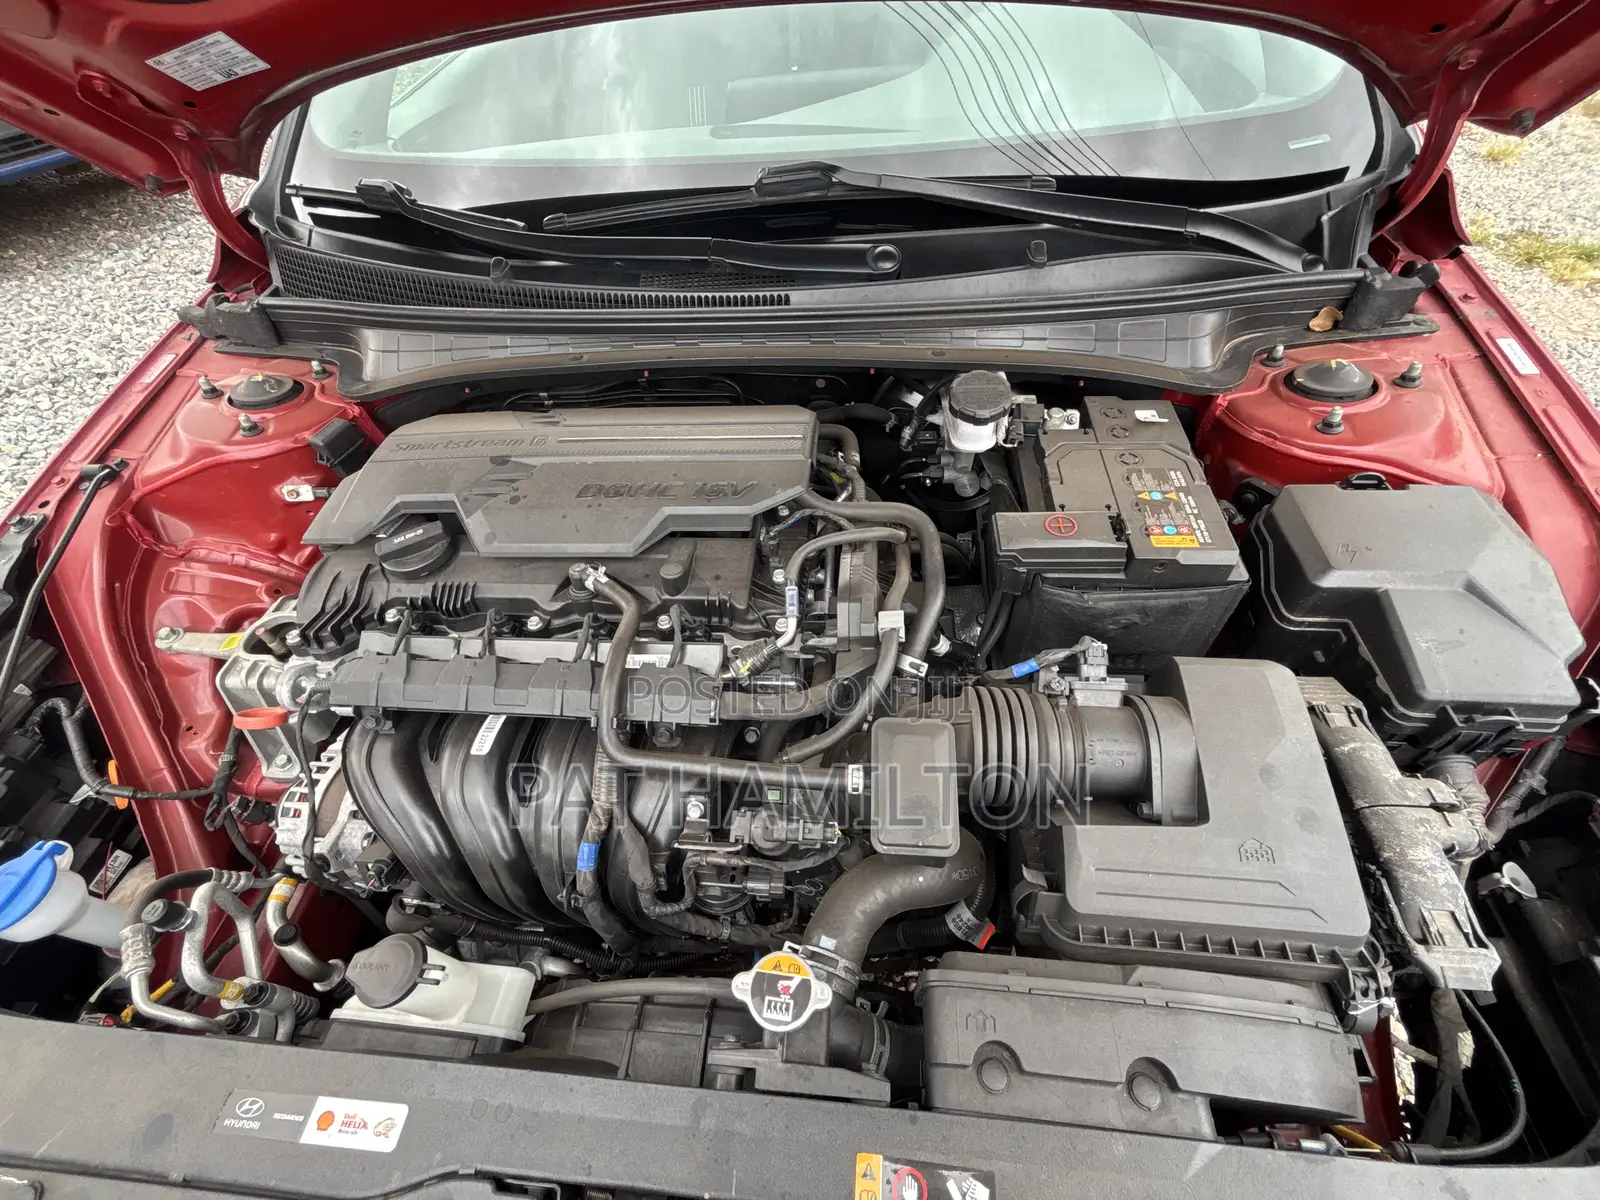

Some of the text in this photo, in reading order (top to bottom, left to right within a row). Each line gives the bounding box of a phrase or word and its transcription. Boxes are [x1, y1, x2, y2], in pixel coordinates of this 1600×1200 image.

[391, 437, 525, 452] Smartstream
[575, 481, 759, 500] DOHC 16V
[223, 1118, 261, 1130] HYUNDAI
[340, 1119, 368, 1130] HELIX
